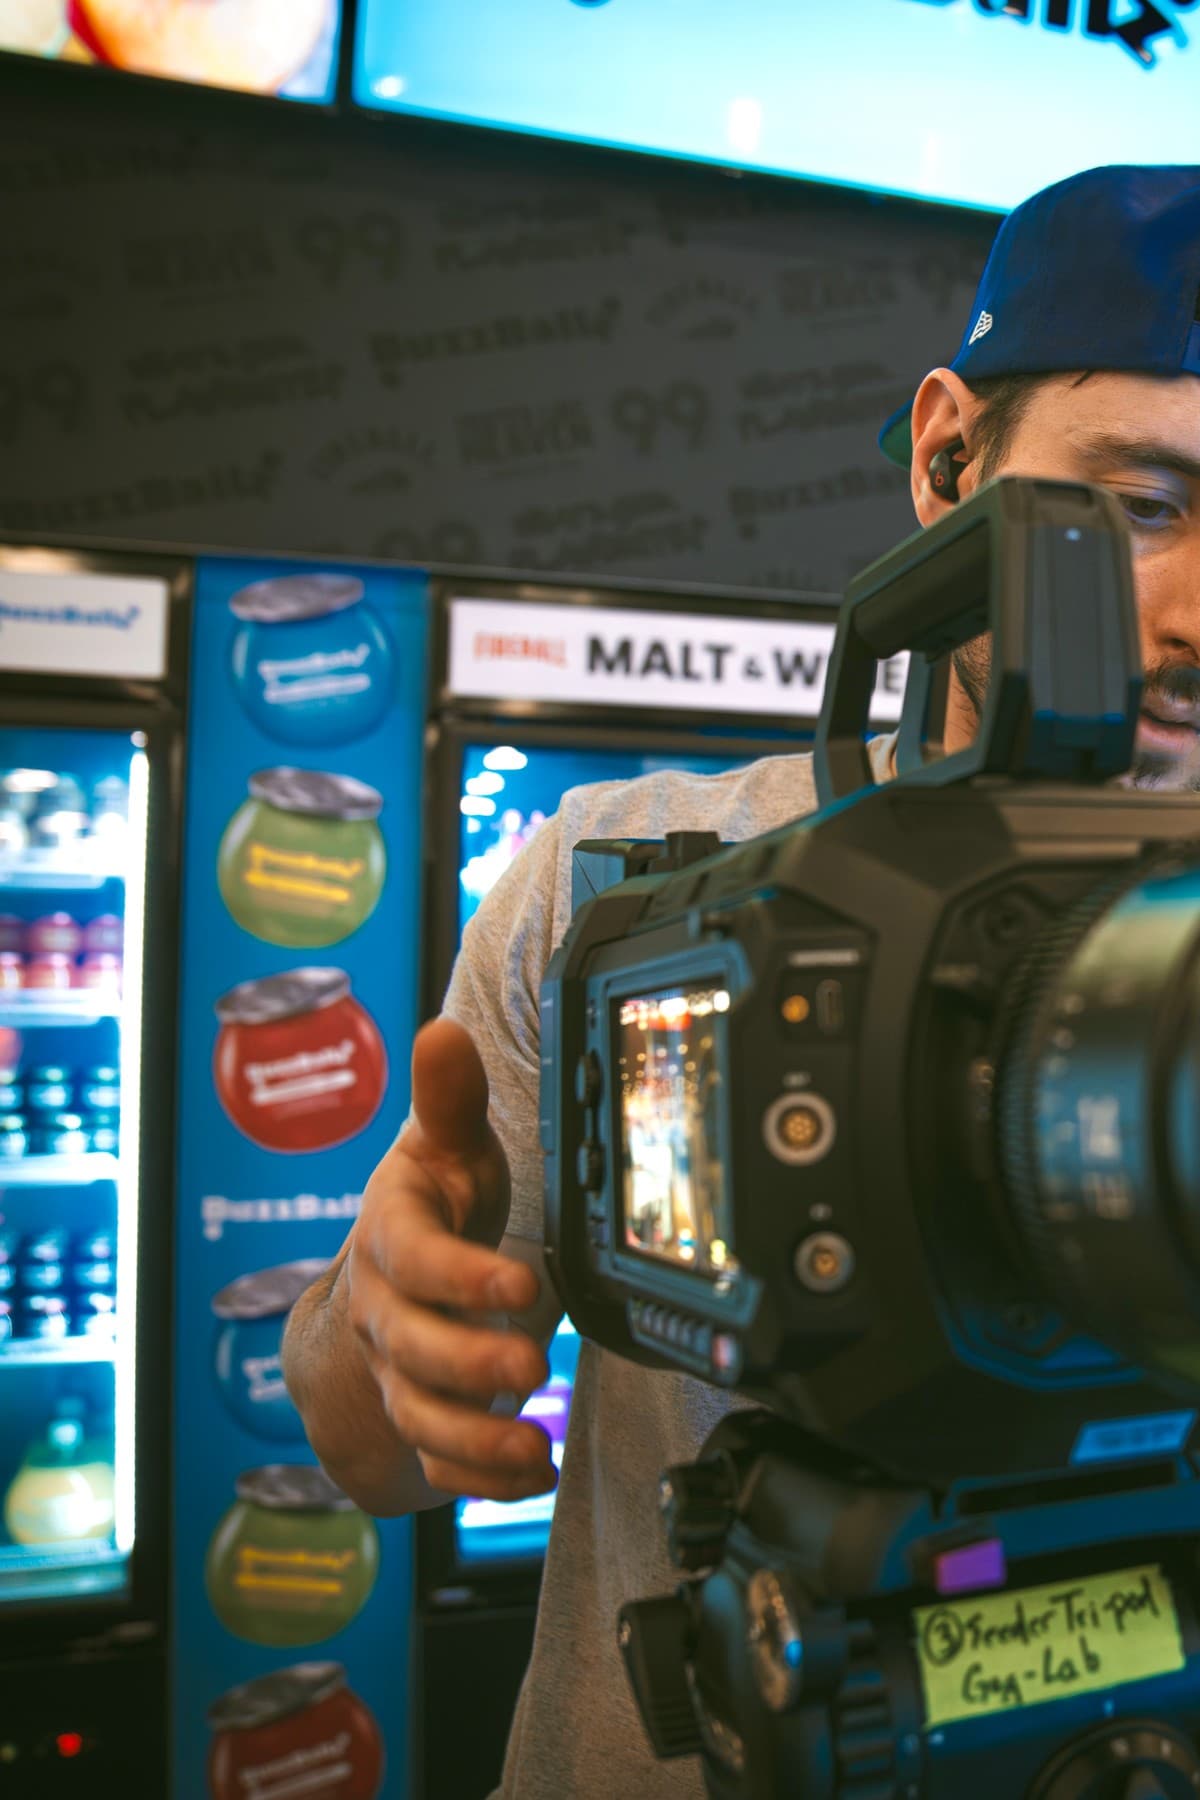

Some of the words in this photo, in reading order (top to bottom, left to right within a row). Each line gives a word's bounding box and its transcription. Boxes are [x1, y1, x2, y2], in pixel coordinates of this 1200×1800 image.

[611, 378, 713, 456] 99
[586, 634, 734, 683] MALT
[742, 654, 764, 680] &
